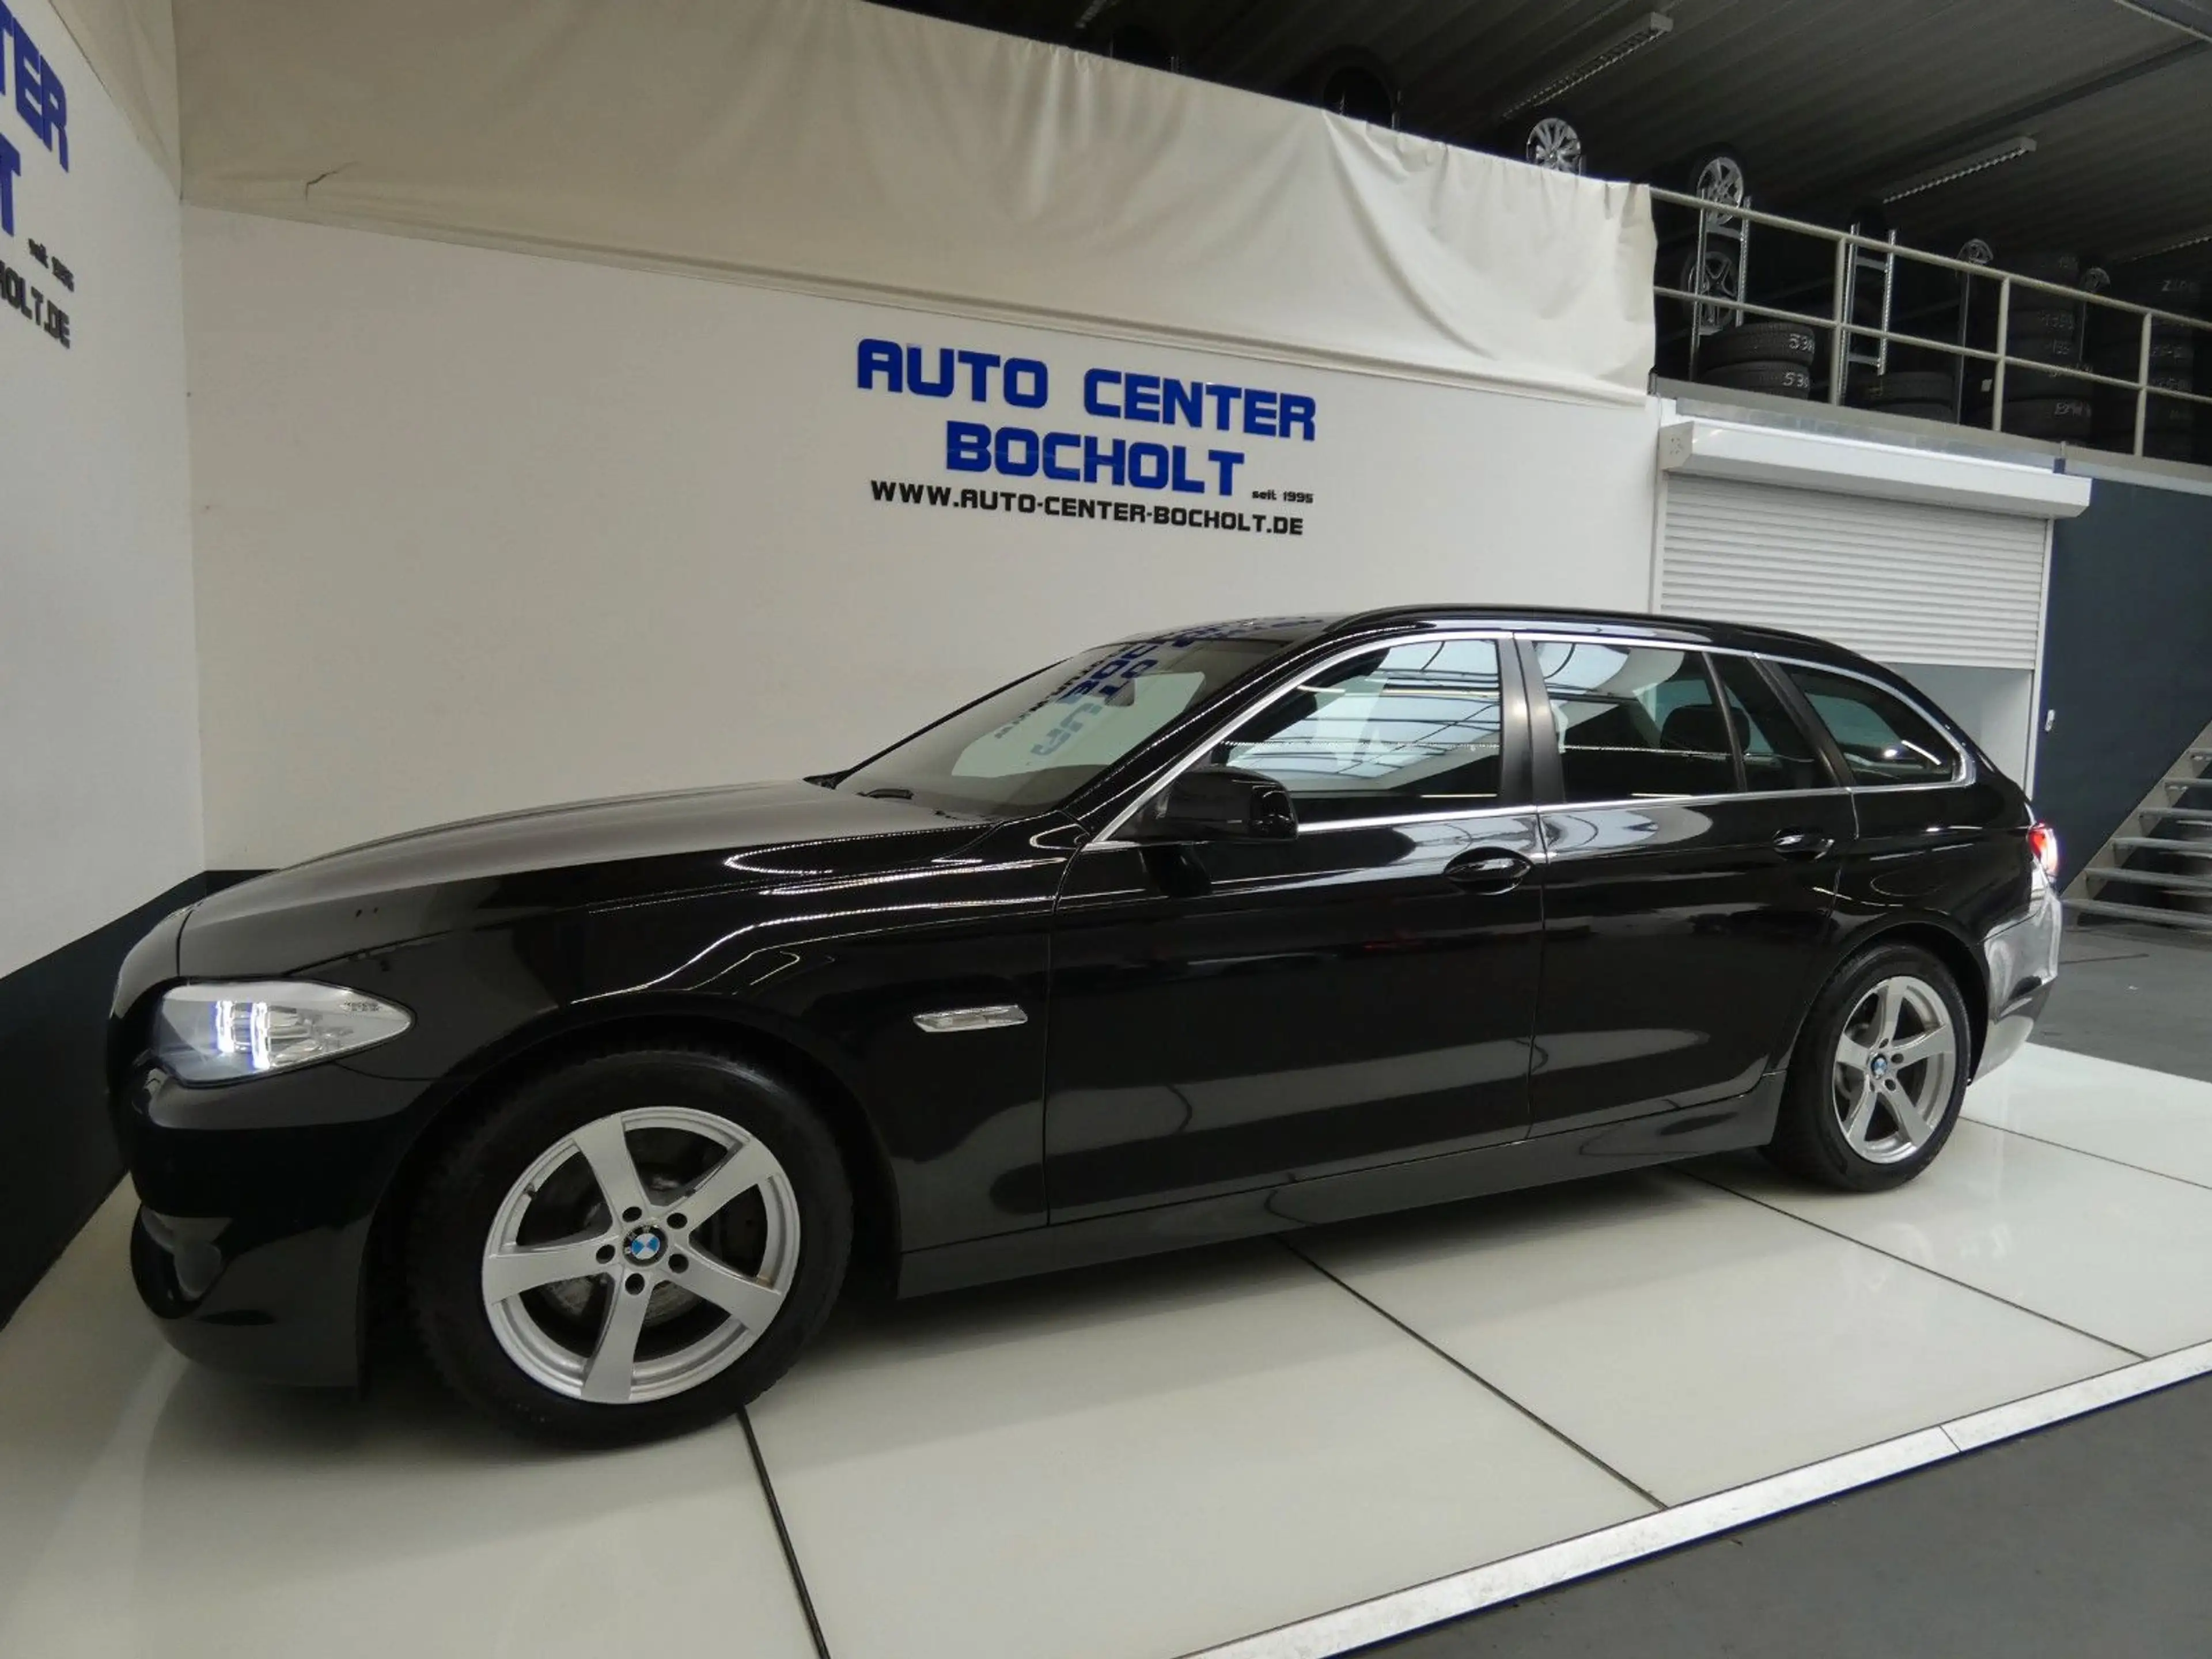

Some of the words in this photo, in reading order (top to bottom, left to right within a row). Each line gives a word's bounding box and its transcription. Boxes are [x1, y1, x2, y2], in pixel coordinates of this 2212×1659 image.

[857, 339, 1048, 408] AUTO
[1084, 368, 1316, 441] CENTER
[946, 421, 1245, 497] BOCHOLT
[870, 480, 1304, 536] WWW.AUTO-CENTER-BOCHOLT.DE
[1252, 490, 1277, 501] seit
[1283, 491, 1314, 504] 1995
